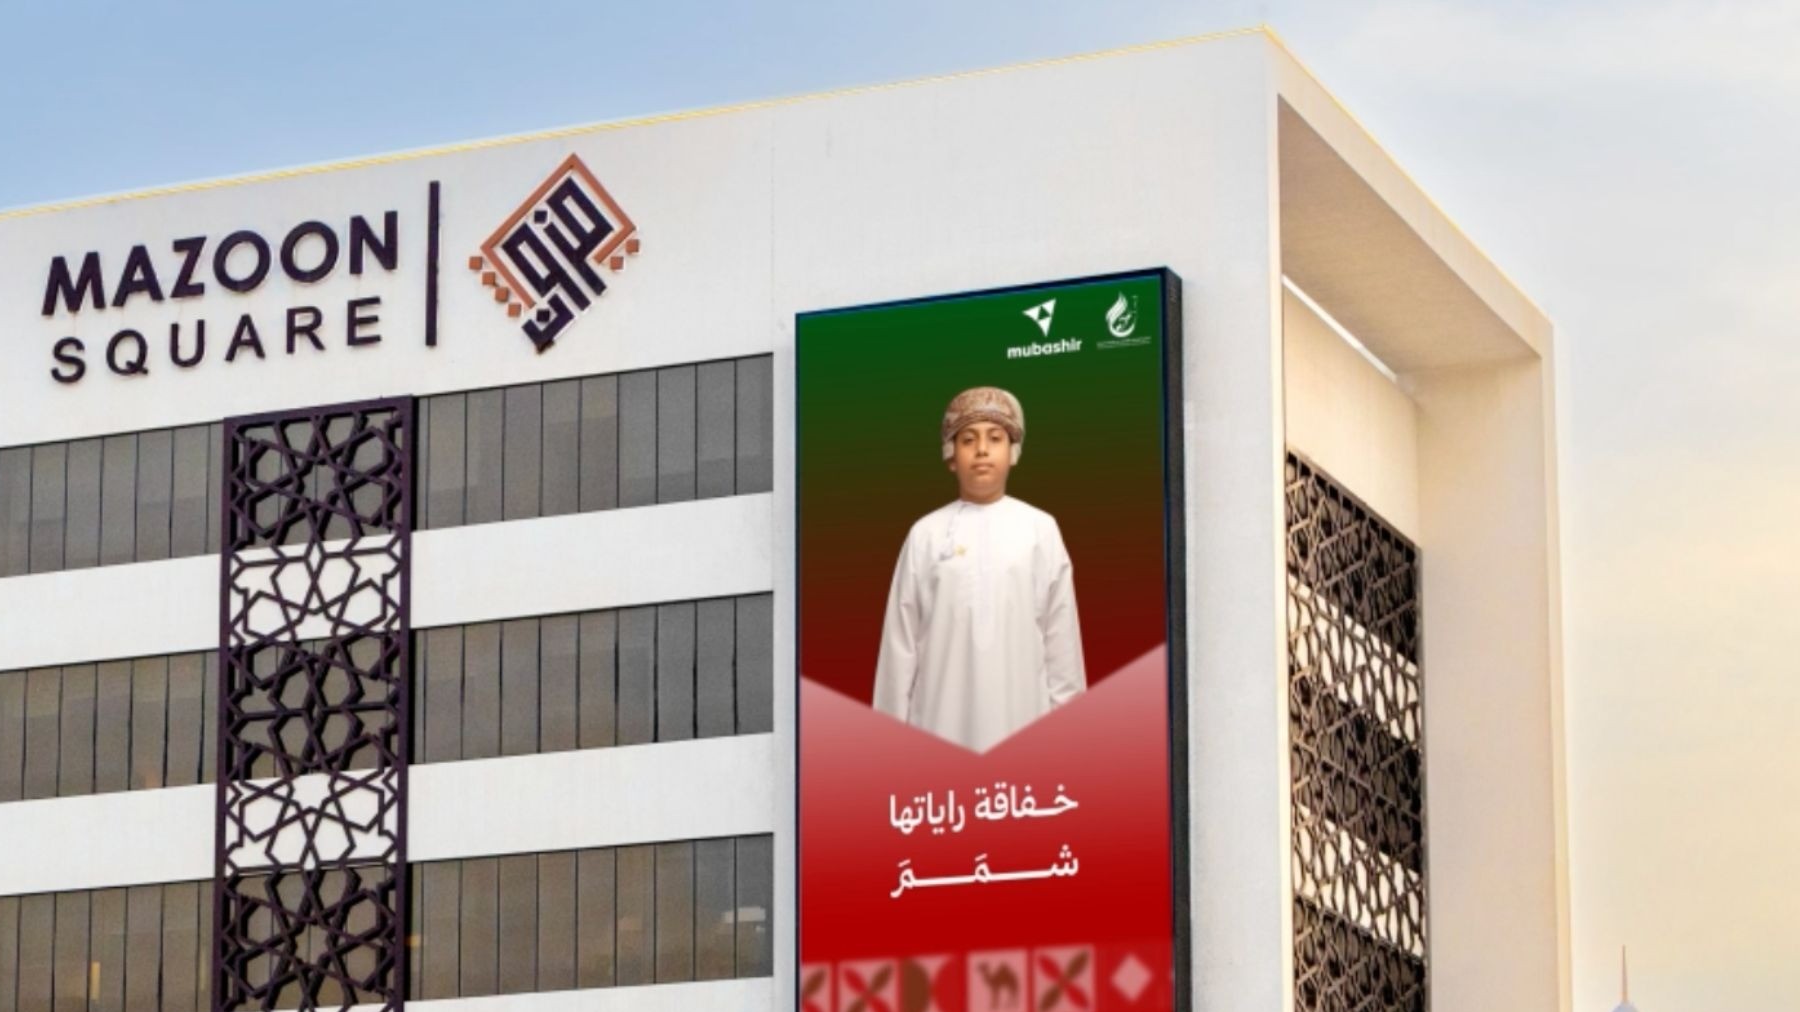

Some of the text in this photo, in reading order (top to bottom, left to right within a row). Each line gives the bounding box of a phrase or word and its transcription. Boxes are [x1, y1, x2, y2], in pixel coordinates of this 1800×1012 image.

[41, 210, 399, 316] MAZOON
[50, 296, 383, 384] SQUARE
[1006, 337, 1083, 359] mubashir
[889, 780, 1080, 836] خفاقة راياتها
